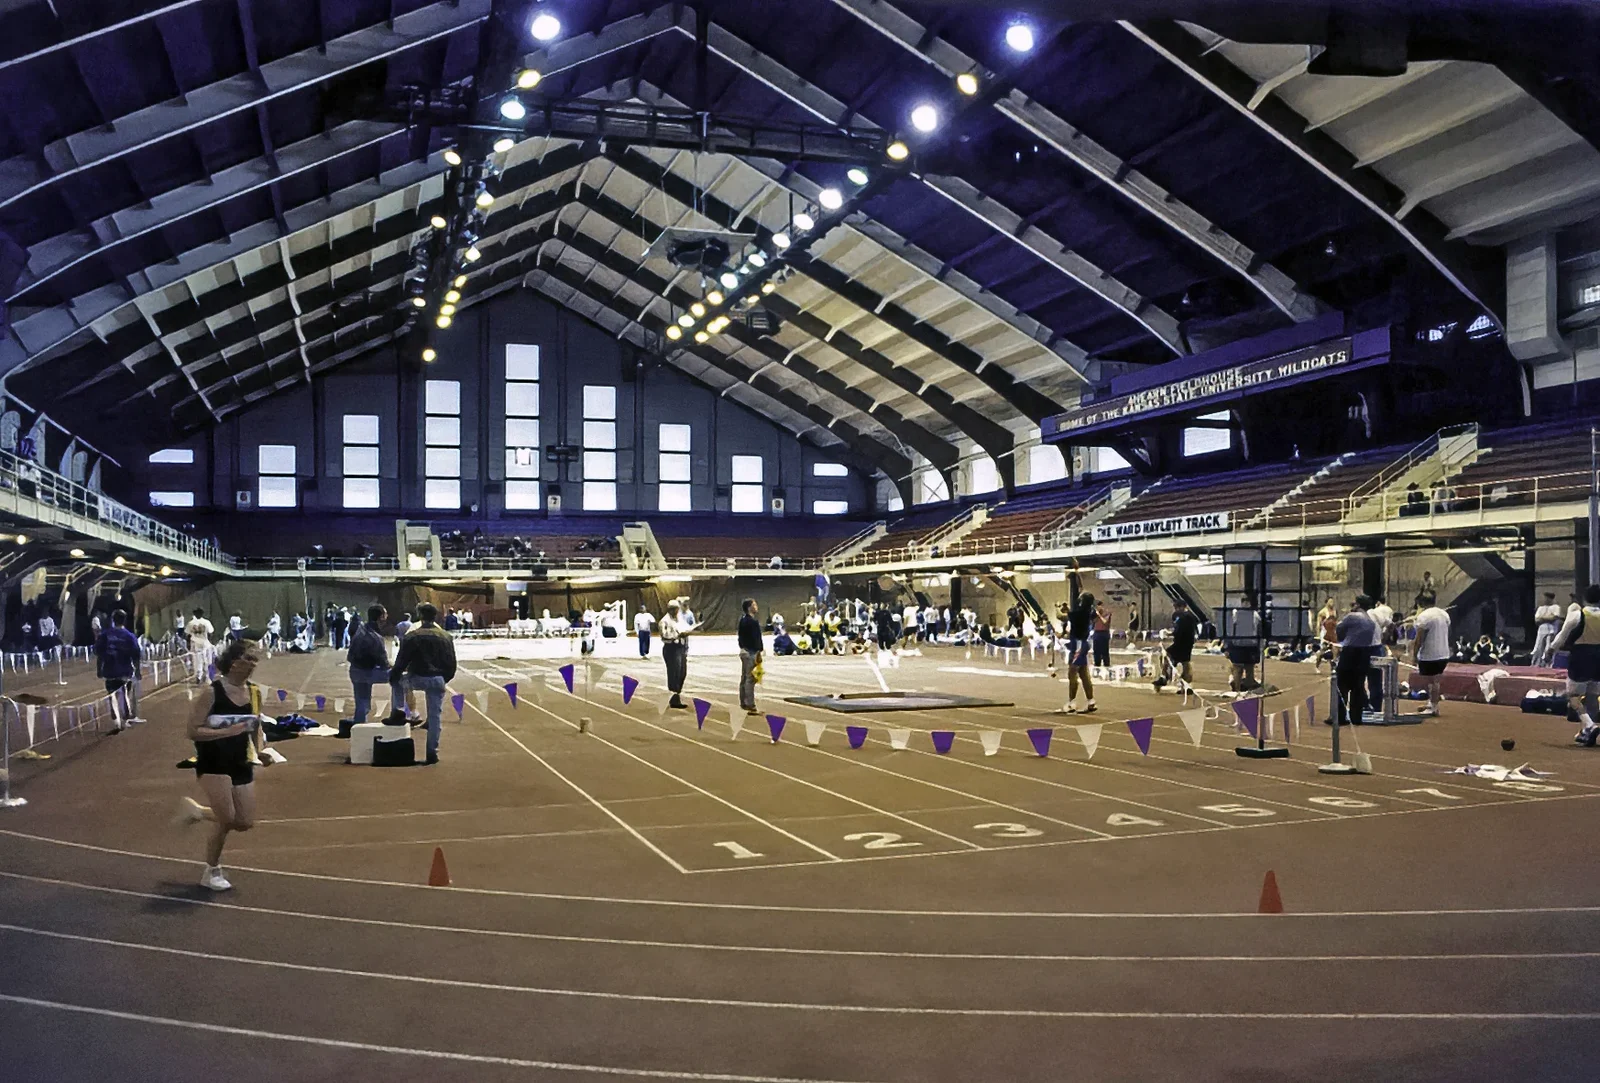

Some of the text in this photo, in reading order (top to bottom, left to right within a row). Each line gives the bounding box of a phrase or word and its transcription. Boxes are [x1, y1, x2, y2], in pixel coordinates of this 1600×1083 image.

[1101, 408, 1119, 420] THE
[1122, 398, 1160, 416] KANSAS
[1163, 387, 1197, 404] STATE
[1200, 369, 1273, 396] UNIVERSITY
[1278, 350, 1346, 377] WILDCATS
[1128, 366, 1242, 406] AHEARN FIELDHOUSE
[1097, 515, 1220, 538] THE WARD HAYLETT TRACK
[713, 840, 766, 860] 1
[843, 831, 924, 850] 2
[973, 822, 1045, 838] 3
[1106, 812, 1165, 827] 4
[1198, 804, 1277, 818] 5
[1308, 796, 1379, 809] 6
[1396, 788, 1463, 800] 7
